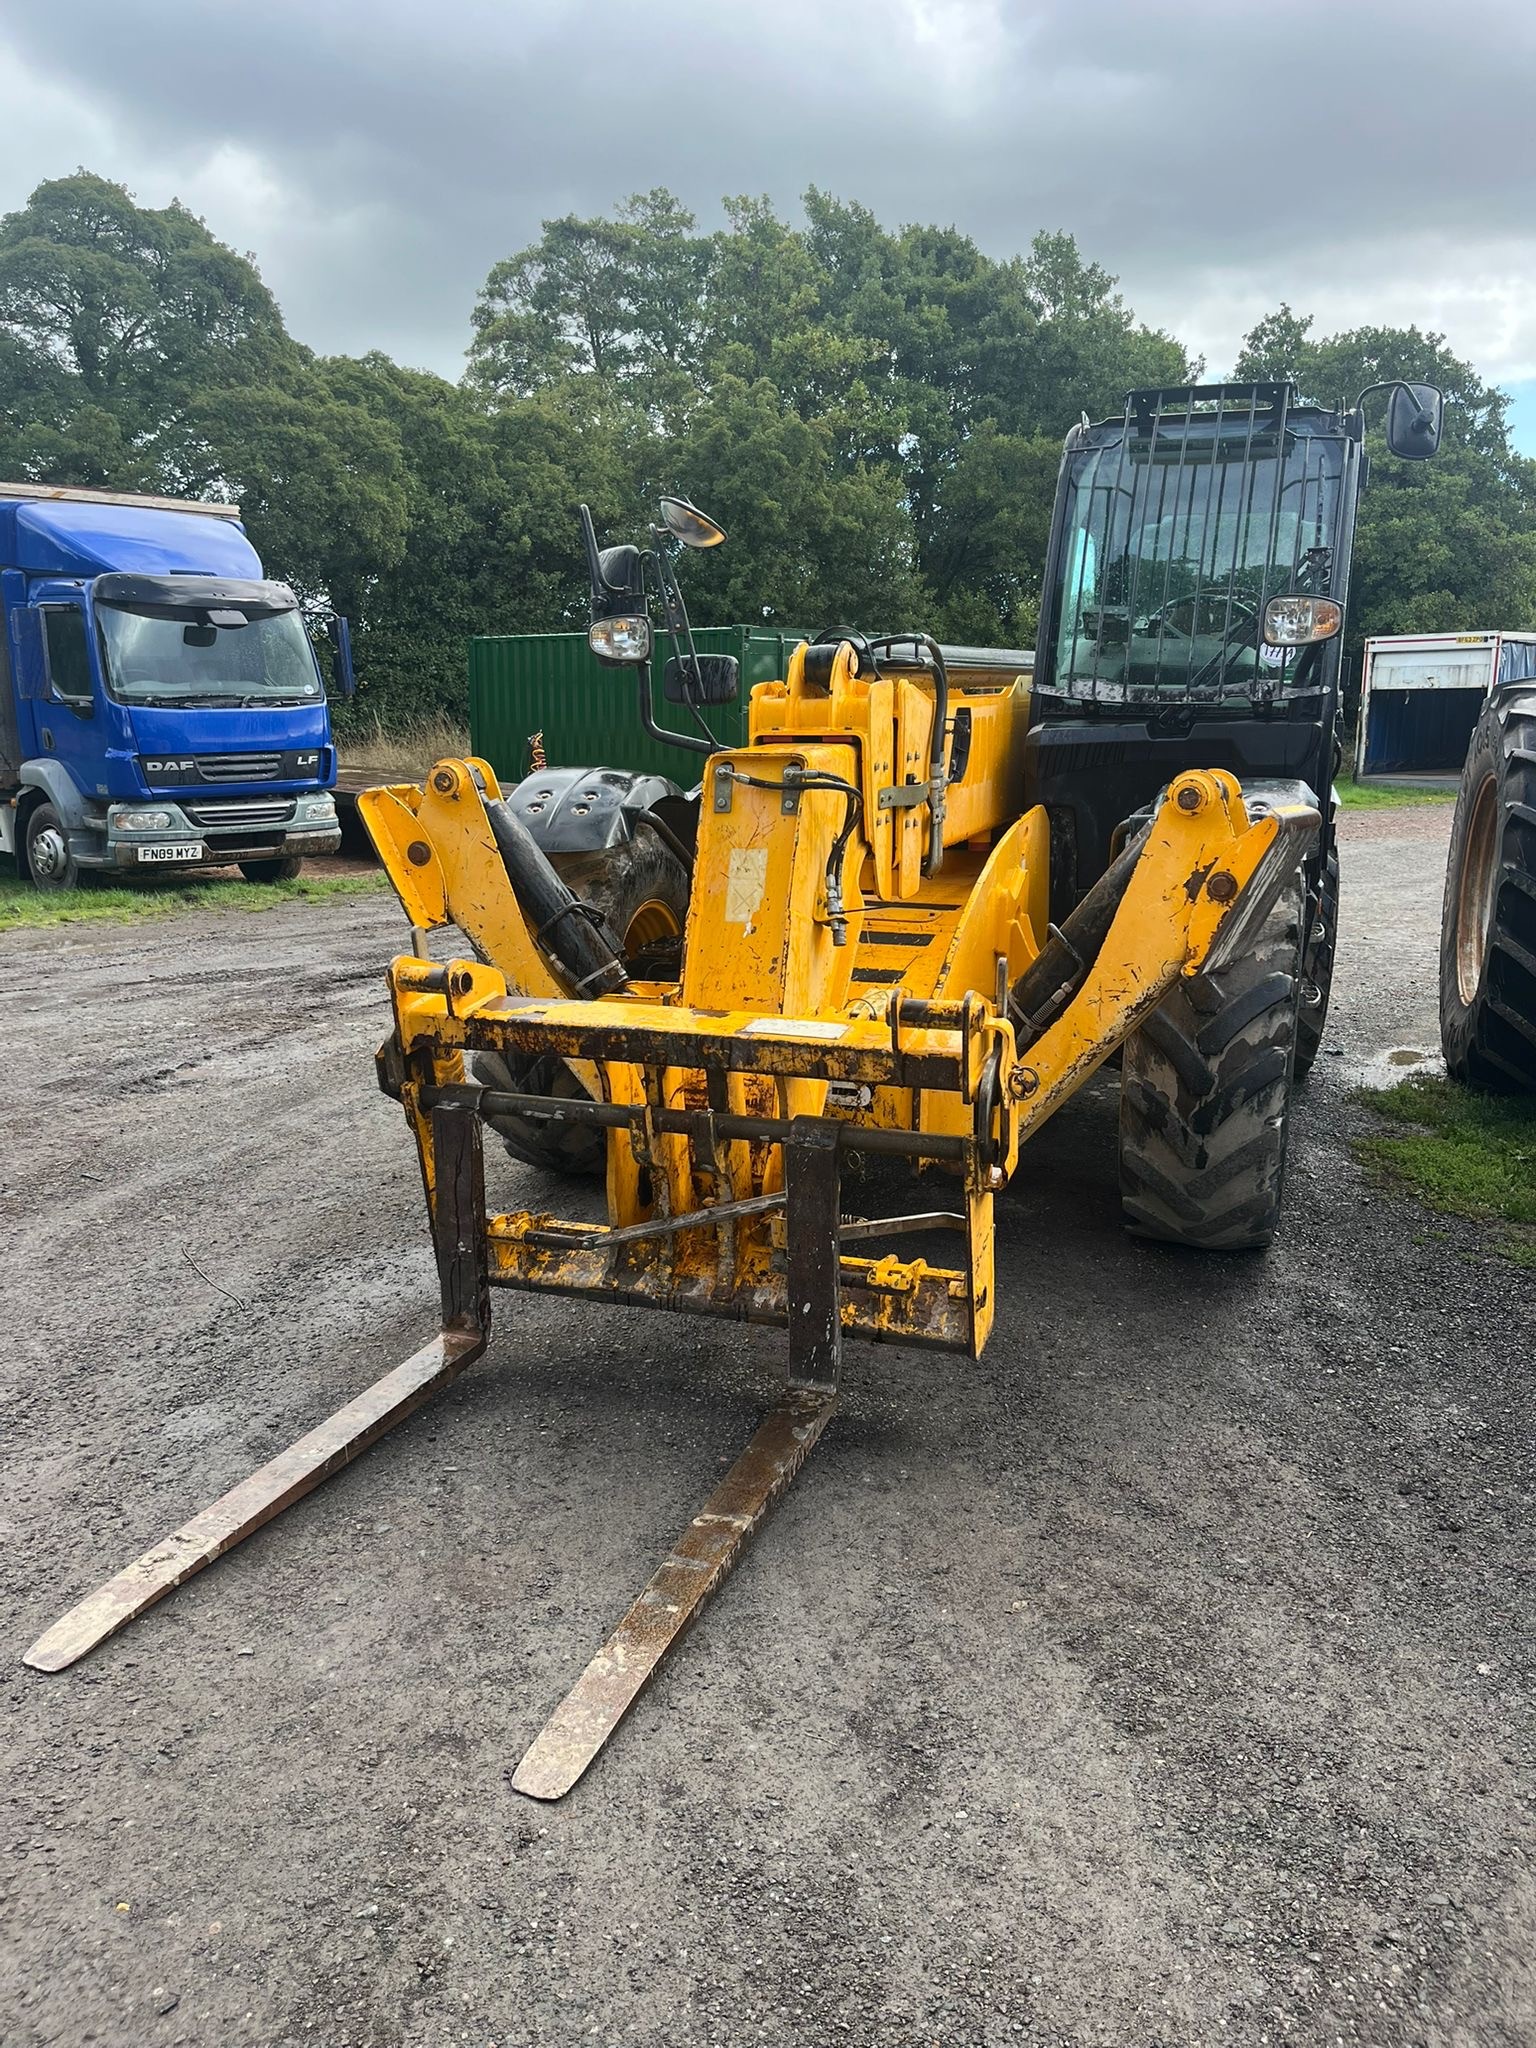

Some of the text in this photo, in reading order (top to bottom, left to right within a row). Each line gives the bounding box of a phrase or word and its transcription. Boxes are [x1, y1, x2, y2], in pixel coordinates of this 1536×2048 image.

[296, 755, 318, 765] LF
[146, 761, 194, 771] DAF
[143, 847, 198, 860] FN09 MYZ
